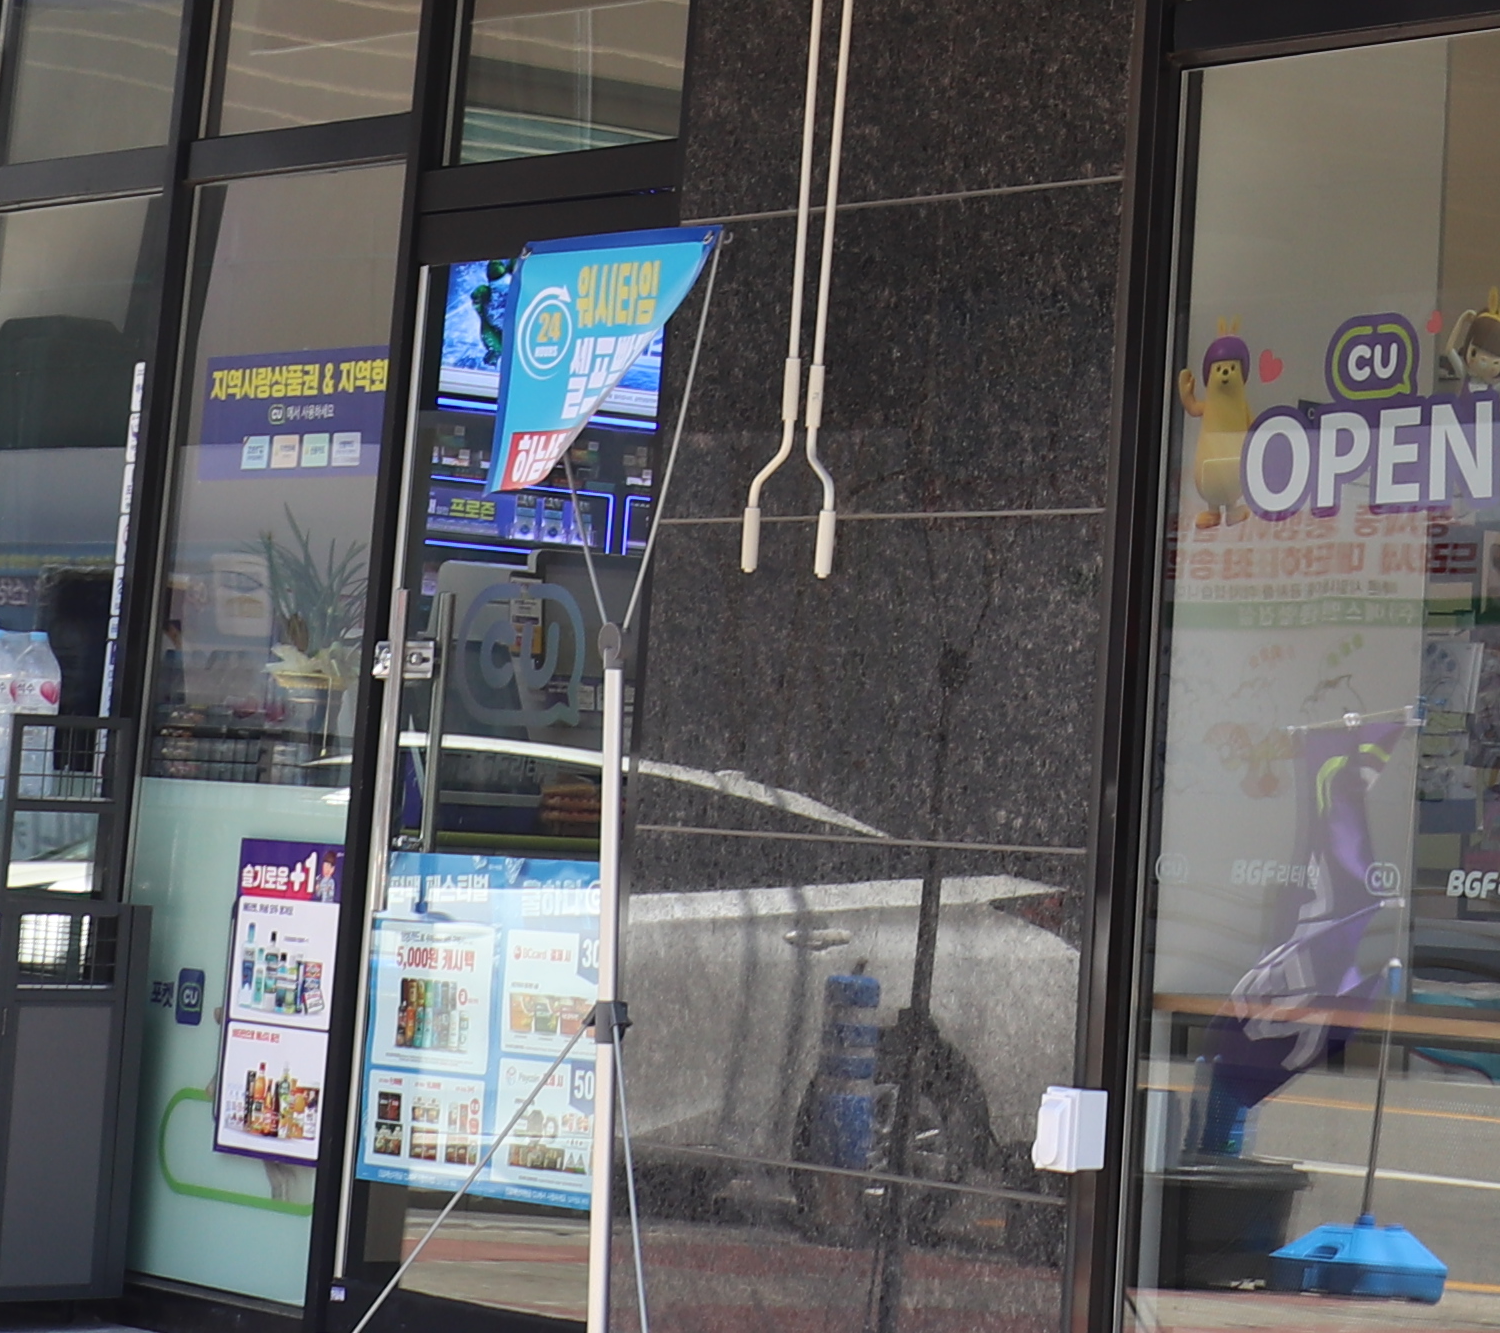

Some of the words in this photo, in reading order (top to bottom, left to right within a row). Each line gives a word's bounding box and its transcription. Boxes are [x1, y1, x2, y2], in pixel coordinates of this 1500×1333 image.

[575, 260, 662, 329] 워시타임
[536, 312, 563, 343] 24
[209, 364, 321, 400] 지역사랑상품권
[322, 362, 335, 395] &
[1347, 342, 1399, 382] CU
[1245, 400, 1495, 513] OPEN
[480, 620, 560, 689] CU
[241, 863, 289, 891] 슬기로운
[1230, 858, 1320, 891] BGF리테일
[395, 945, 440, 971] 5,000원
